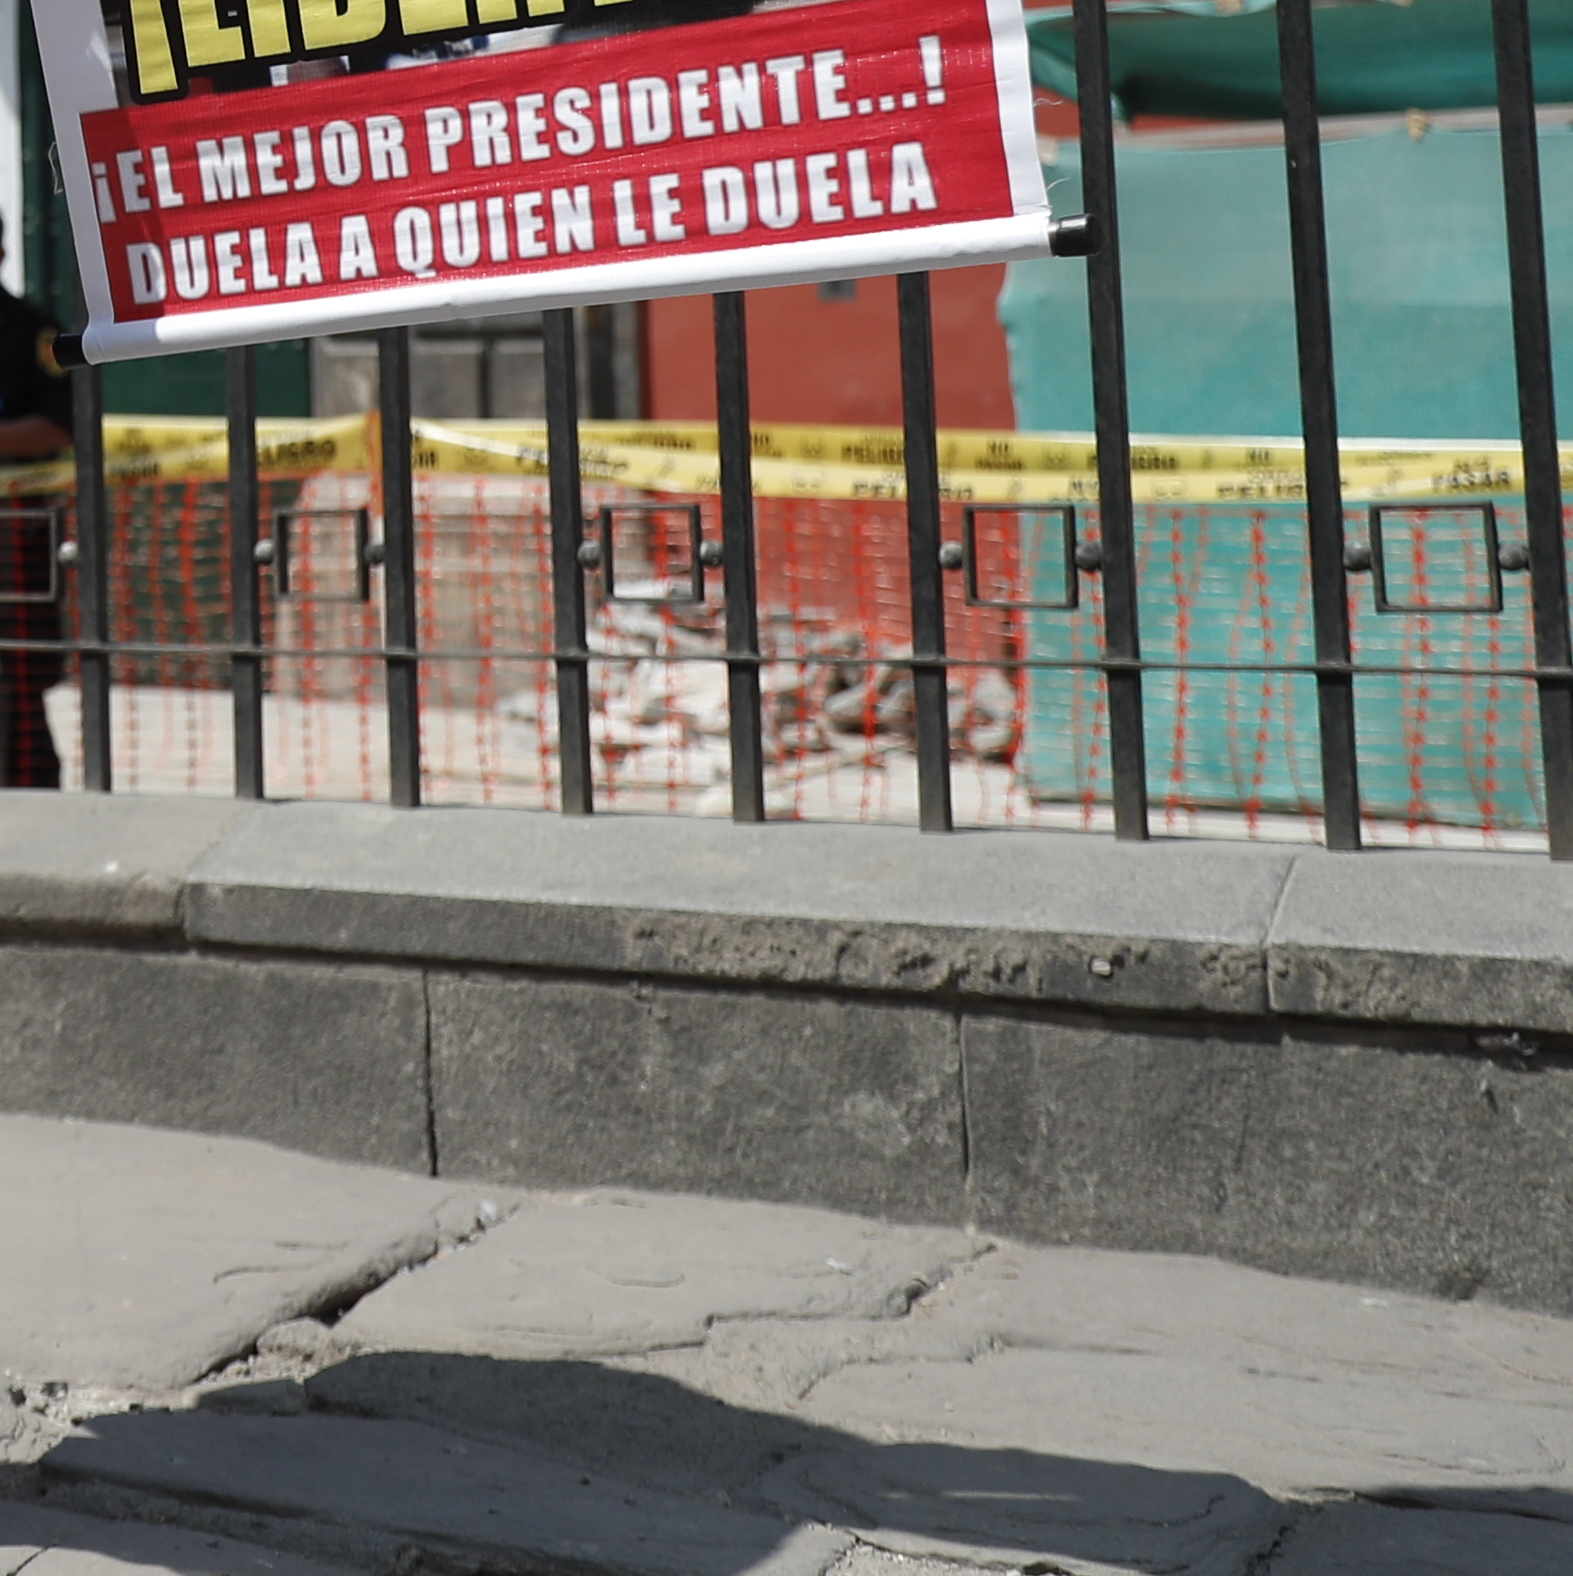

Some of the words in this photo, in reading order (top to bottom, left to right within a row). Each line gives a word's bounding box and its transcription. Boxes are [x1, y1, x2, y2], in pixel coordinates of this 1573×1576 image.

[93, 149, 185, 222] ¡EL
[196, 115, 408, 204] MEJOR
[426, 36, 948, 174] PRESIDENTE...!
[125, 222, 323, 306] DUELA
[339, 215, 394, 280] A
[403, 184, 593, 278] QUIEN
[615, 175, 684, 246] LE
[702, 142, 938, 229] DUELA
